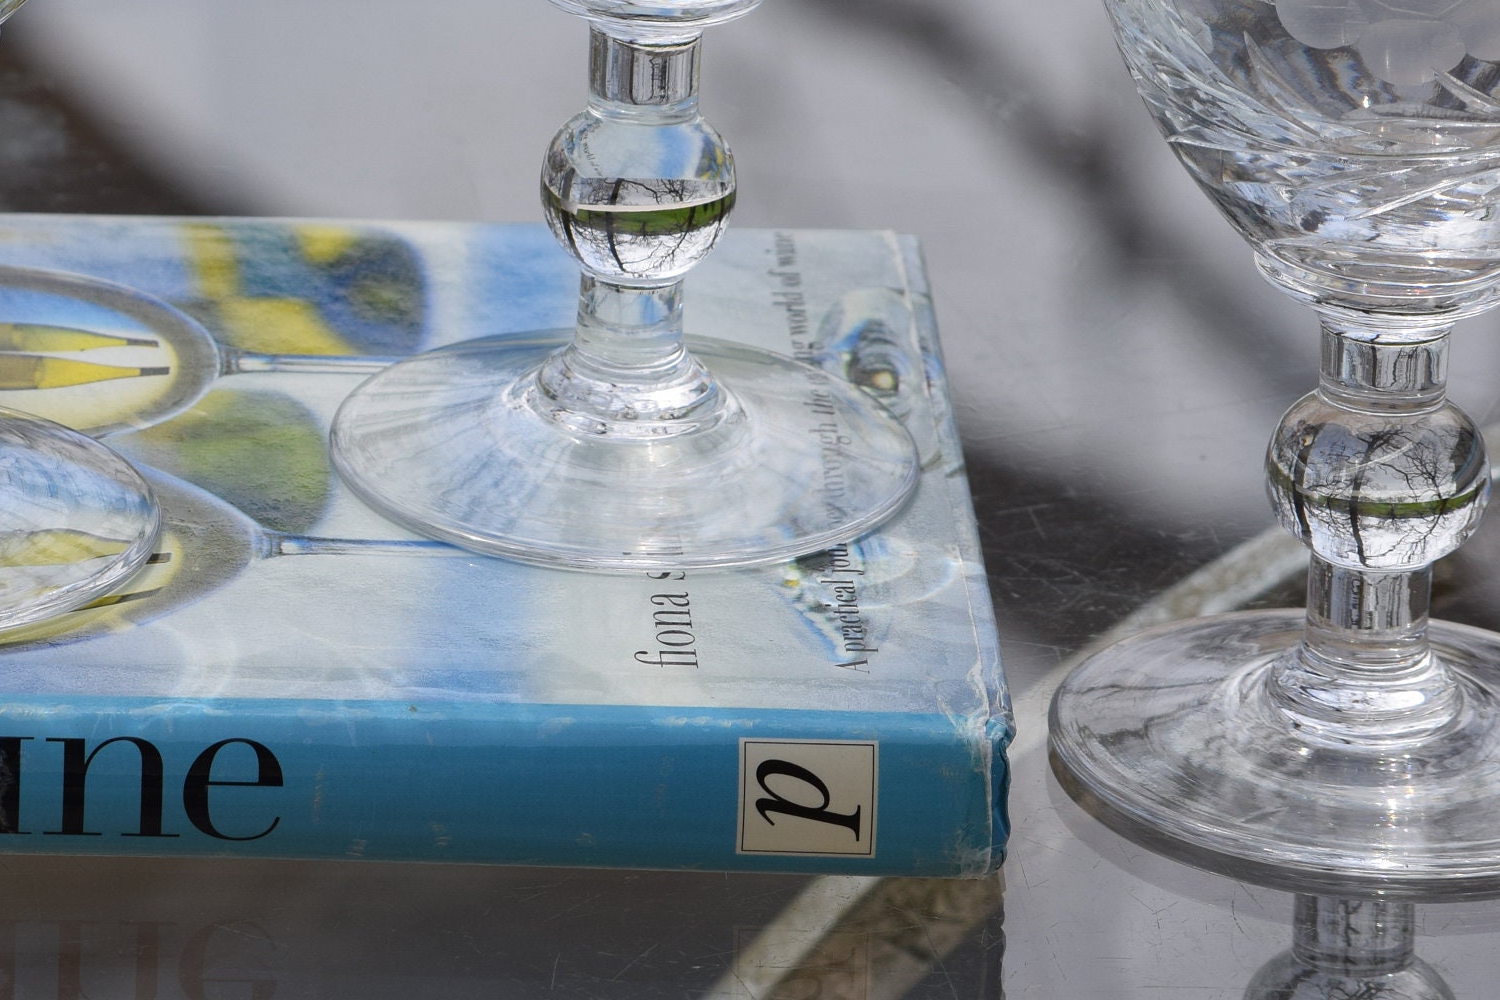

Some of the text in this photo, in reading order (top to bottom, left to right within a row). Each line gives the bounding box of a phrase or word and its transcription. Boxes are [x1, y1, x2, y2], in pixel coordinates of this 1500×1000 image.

[764, 231, 795, 267] wine
[767, 270, 800, 287] of
[772, 292, 808, 335] world
[803, 389, 835, 415] the
[808, 424, 851, 500] through
[817, 503, 865, 576] jourey
[634, 592, 698, 668] fiona
[820, 580, 879, 653] practical
[834, 658, 870, 674] A
